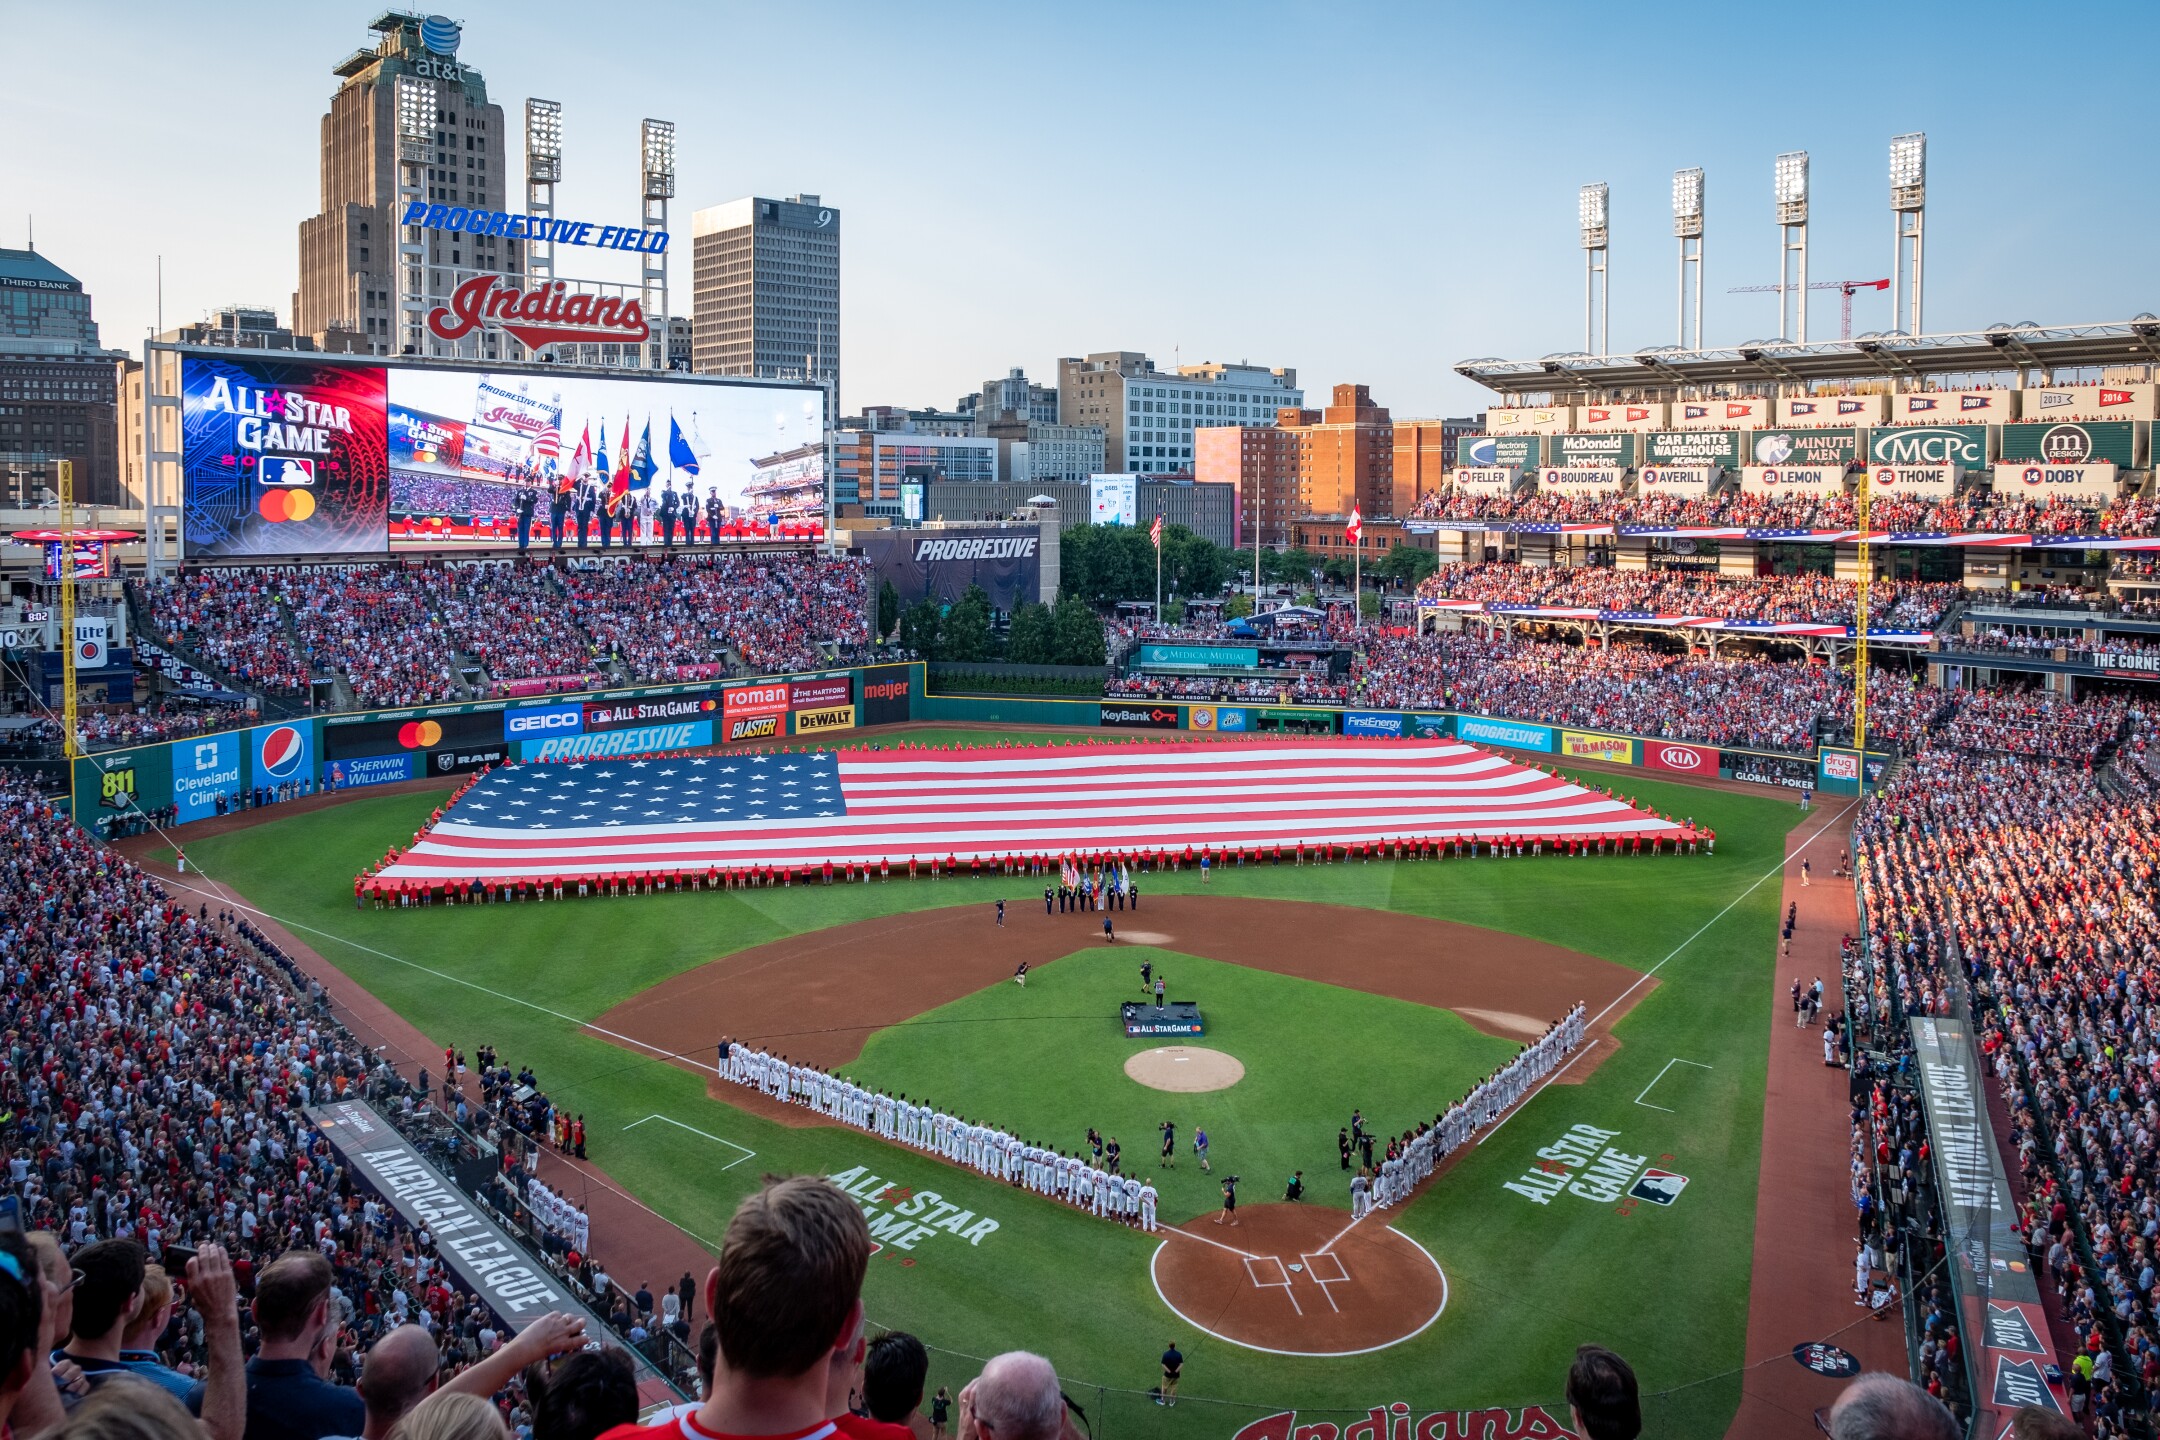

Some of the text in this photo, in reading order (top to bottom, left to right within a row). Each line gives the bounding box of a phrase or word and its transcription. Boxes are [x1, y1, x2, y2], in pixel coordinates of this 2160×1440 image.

[416, 58, 466, 83] at&t
[815, 209, 832, 228] 9
[402, 201, 671, 255] PROGRESSIVE FIELD
[0, 277, 70, 291] THIRD BANK
[428, 275, 650, 350] Indians
[478, 382, 538, 408] PROGRESSIVE
[2044, 394, 2062, 404] 2013
[2102, 393, 2122, 402] 2016
[202, 376, 353, 434] ALL STAR
[1793, 404, 1808, 412] 1998
[1840, 403, 1856, 411] 1999
[1910, 400, 1928, 409] 2001
[1963, 398, 1981, 408] 2007
[1628, 409, 1642, 419] 1995
[1686, 407, 1700, 417] 1996
[1728, 406, 1742, 415] 1997
[484, 406, 544, 433] Indian
[1500, 414, 1513, 422] 1920
[400, 412, 423, 430] ALL
[428, 422, 454, 441] STAR
[237, 417, 330, 454] GAME
[408, 426, 444, 445] GAME
[1656, 434, 1728, 445] CAR PARTS
[1496, 442, 1528, 450] electronic
[1563, 436, 1622, 449] McDonald
[1794, 436, 1854, 449] MINUTE
[1654, 444, 1732, 456] WAREHOUSE
[1806, 449, 1840, 460] MEN
[1496, 456, 1524, 464] systems
[1568, 455, 1616, 468] Hopkins
[1460, 472, 1504, 482] 19 FELLER
[1550, 472, 1614, 483] 5 BOUDREAU
[1646, 472, 1704, 483] 3 AVERILL
[1780, 472, 1821, 483] LEMON
[1879, 470, 1944, 482] 25 THOME
[2026, 470, 2084, 483] 14 DOBY
[915, 537, 1038, 560] PROGRESSIVE
[566, 556, 631, 570] NOCO
[678, 551, 799, 563] START DEAD BATTERIES
[200, 567, 252, 580] START
[256, 566, 296, 578] DEAD
[28, 612, 48, 621] 8:02
[75, 627, 104, 642] Lite
[1169, 650, 1246, 660] MEDICAL MUTUAL
[2092, 653, 2116, 667] THE
[812, 687, 845, 695] HARTFORD
[864, 679, 909, 700] meijer
[519, 698, 552, 707] PROGRESSIVE
[728, 688, 786, 706] roman
[426, 706, 463, 714] PROGRESSIVE
[474, 702, 508, 711] PROGRESSIVE
[613, 701, 700, 721] ALL STAR GAME
[328, 715, 366, 724] PROGRESSIVE
[377, 711, 415, 719] PROGRESSIVE
[1102, 710, 1150, 722] KeyBank
[510, 712, 578, 732] GEICO
[1348, 716, 1401, 729] FirstEnergy
[1462, 722, 1544, 746] PROGRESSIVE
[538, 724, 695, 762] PROGRESSIVE
[458, 752, 500, 764] RAM
[1667, 750, 1694, 764] KIA
[1826, 753, 1852, 770] drug
[350, 758, 404, 773] SHERWIN
[1828, 766, 1857, 778] mart
[102, 770, 134, 797] 811
[176, 768, 238, 793] Cleveland
[1736, 772, 1814, 790] GLOBAL POKER
[190, 788, 225, 806] Clinic
[97, 814, 114, 825] Call
[1155, 1025, 1172, 1034] STAR
[1926, 1062, 1976, 1118] LEAGUE
[1502, 1124, 1622, 1206] ALL STAR
[1936, 1122, 2002, 1210] NATIONAL
[1568, 1147, 1648, 1203] GAME
[361, 1148, 482, 1236] AMERICAN
[827, 1165, 1000, 1246] ALL STAR
[447, 1231, 560, 1313] LEAGUE
[1992, 1318, 2028, 1347] 2018
[2003, 1370, 2042, 1406] 2017
